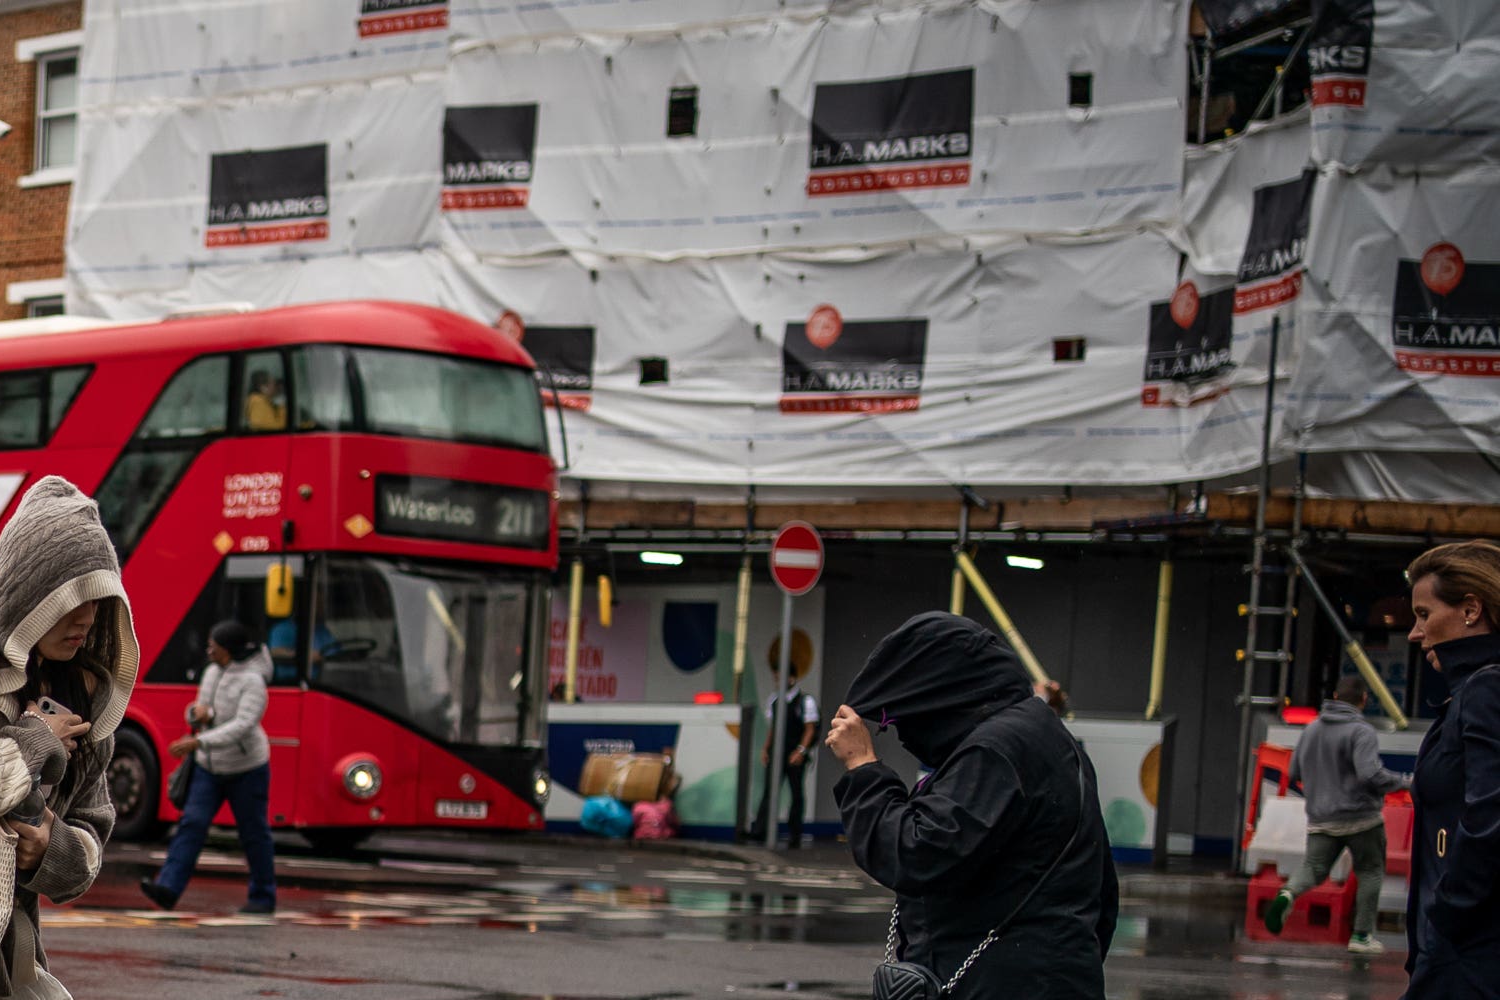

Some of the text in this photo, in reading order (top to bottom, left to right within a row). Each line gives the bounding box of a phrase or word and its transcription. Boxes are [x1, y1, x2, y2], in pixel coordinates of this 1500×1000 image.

[224, 472, 283, 491] LONDON
[224, 489, 282, 507] UNITED
[386, 490, 534, 537] Waterloo 211
